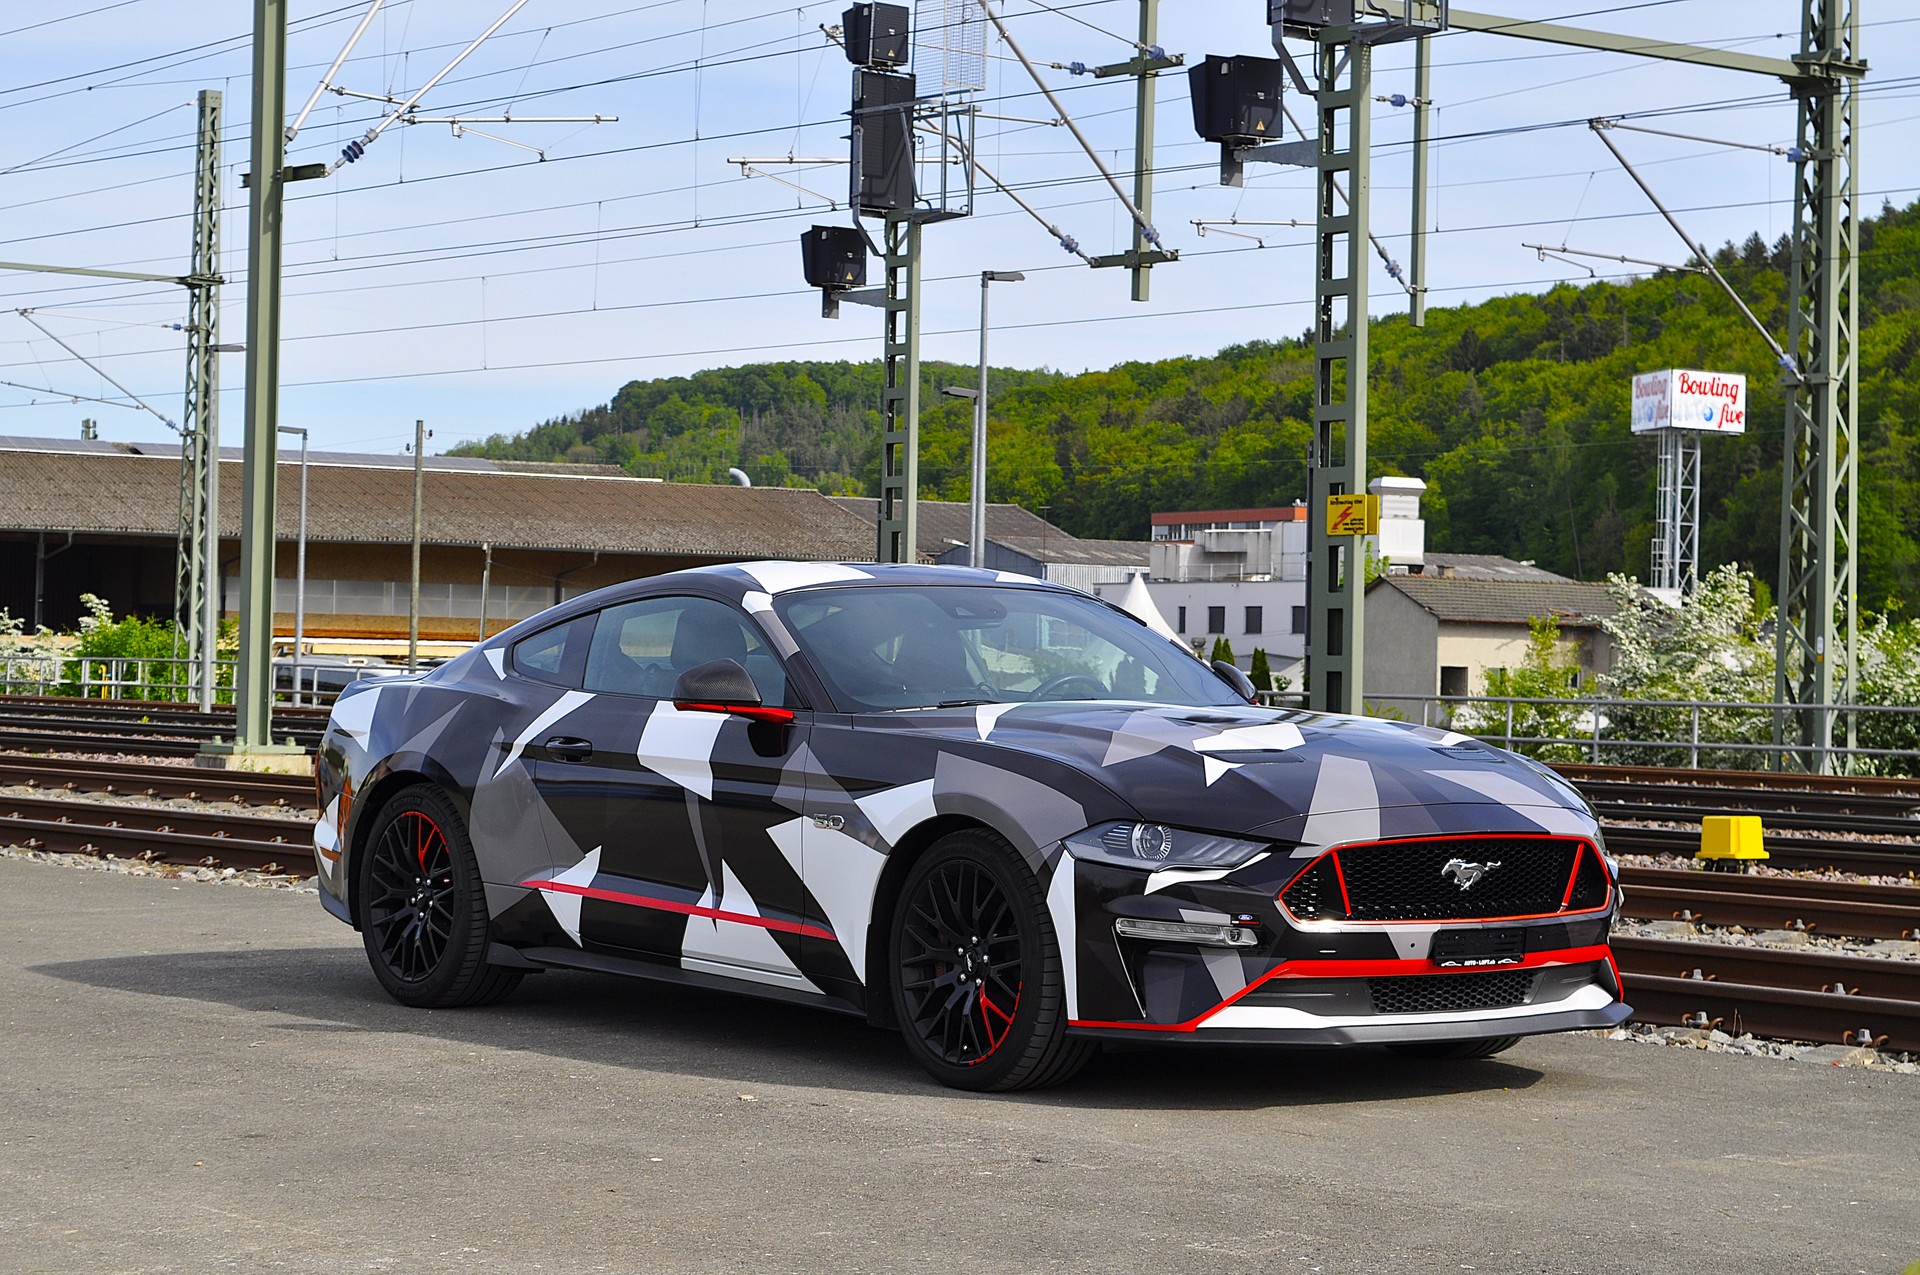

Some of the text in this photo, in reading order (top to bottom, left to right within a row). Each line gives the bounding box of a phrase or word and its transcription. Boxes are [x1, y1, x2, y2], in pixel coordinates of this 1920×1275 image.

[1635, 376, 1667, 400] Bowling
[1679, 372, 1739, 404] Bowling
[1717, 403, 1744, 428] five
[813, 813, 845, 830] 5.0
